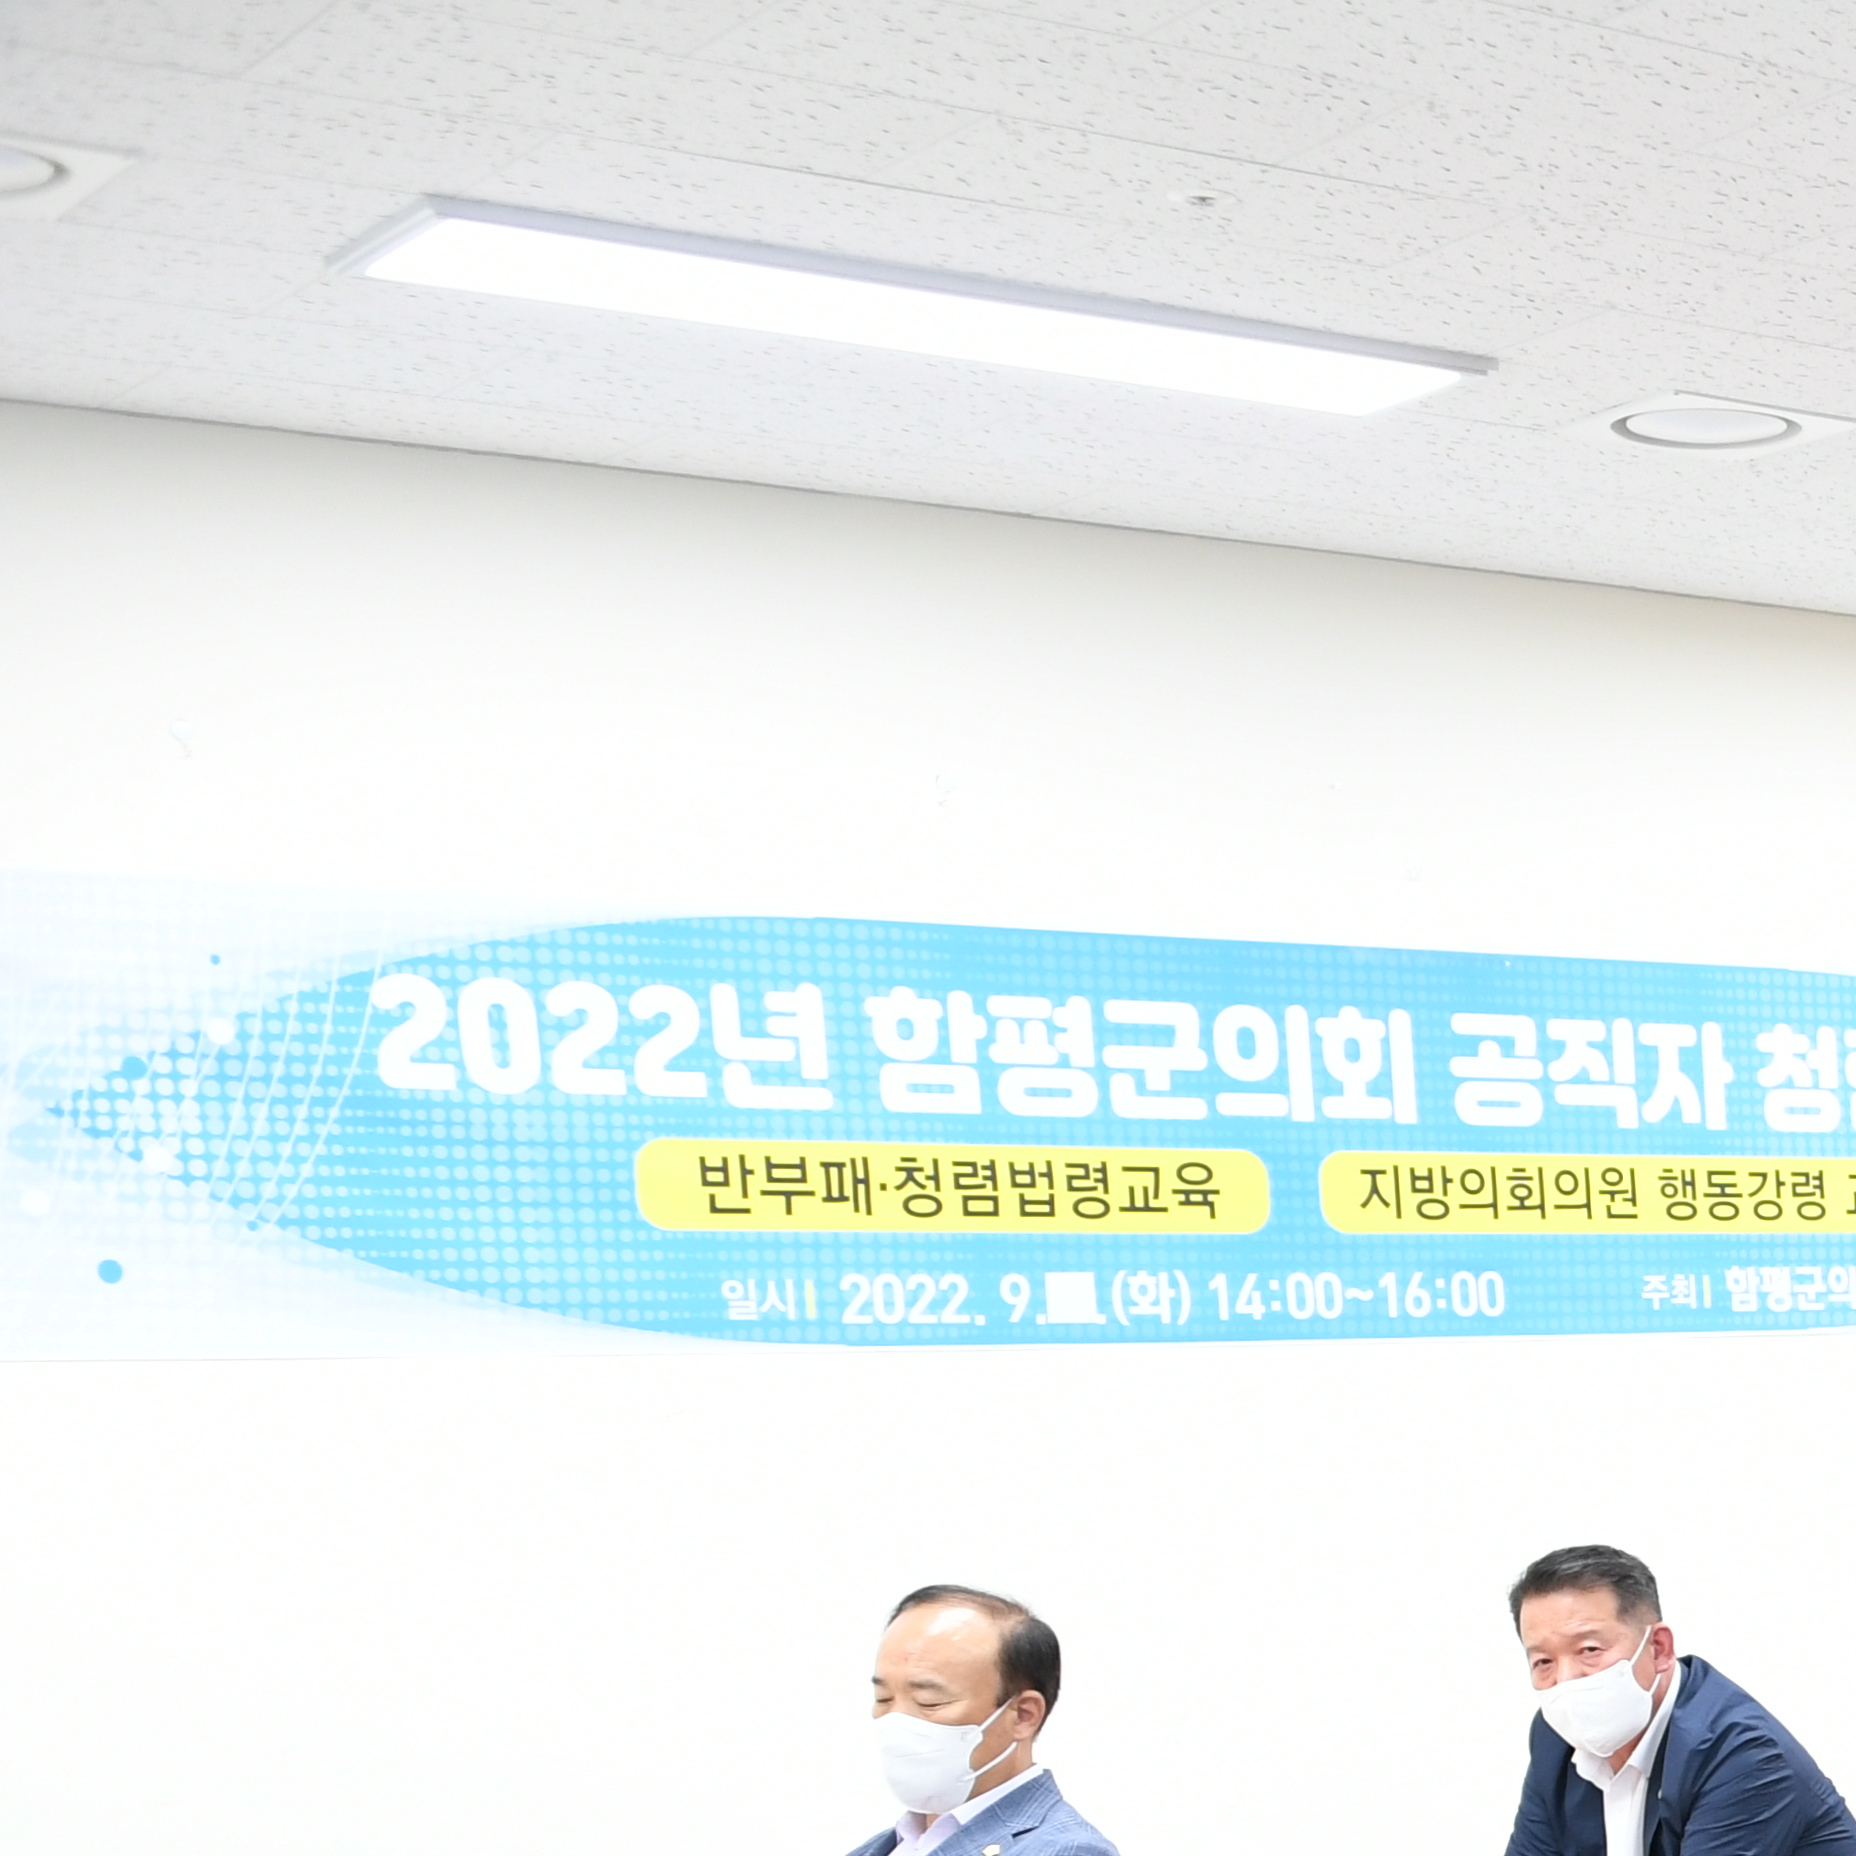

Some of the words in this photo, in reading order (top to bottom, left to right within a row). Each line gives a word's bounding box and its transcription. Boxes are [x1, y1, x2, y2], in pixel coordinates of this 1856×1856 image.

[371, 973, 834, 1110] 2022년
[864, 986, 1418, 1124] 함평군의회
[1449, 1013, 1734, 1131] 공직자
[699, 1154, 1220, 1220] 반부패·청렴법령교육
[1360, 1165, 1639, 1221] 지방의회의원
[1658, 1167, 1827, 1221] 행동강령
[721, 1278, 797, 1322] 일시
[840, 1273, 986, 1326] 2022.
[1208, 1270, 1504, 1321] 14:00~16:00
[1641, 1274, 1698, 1310] 주최
